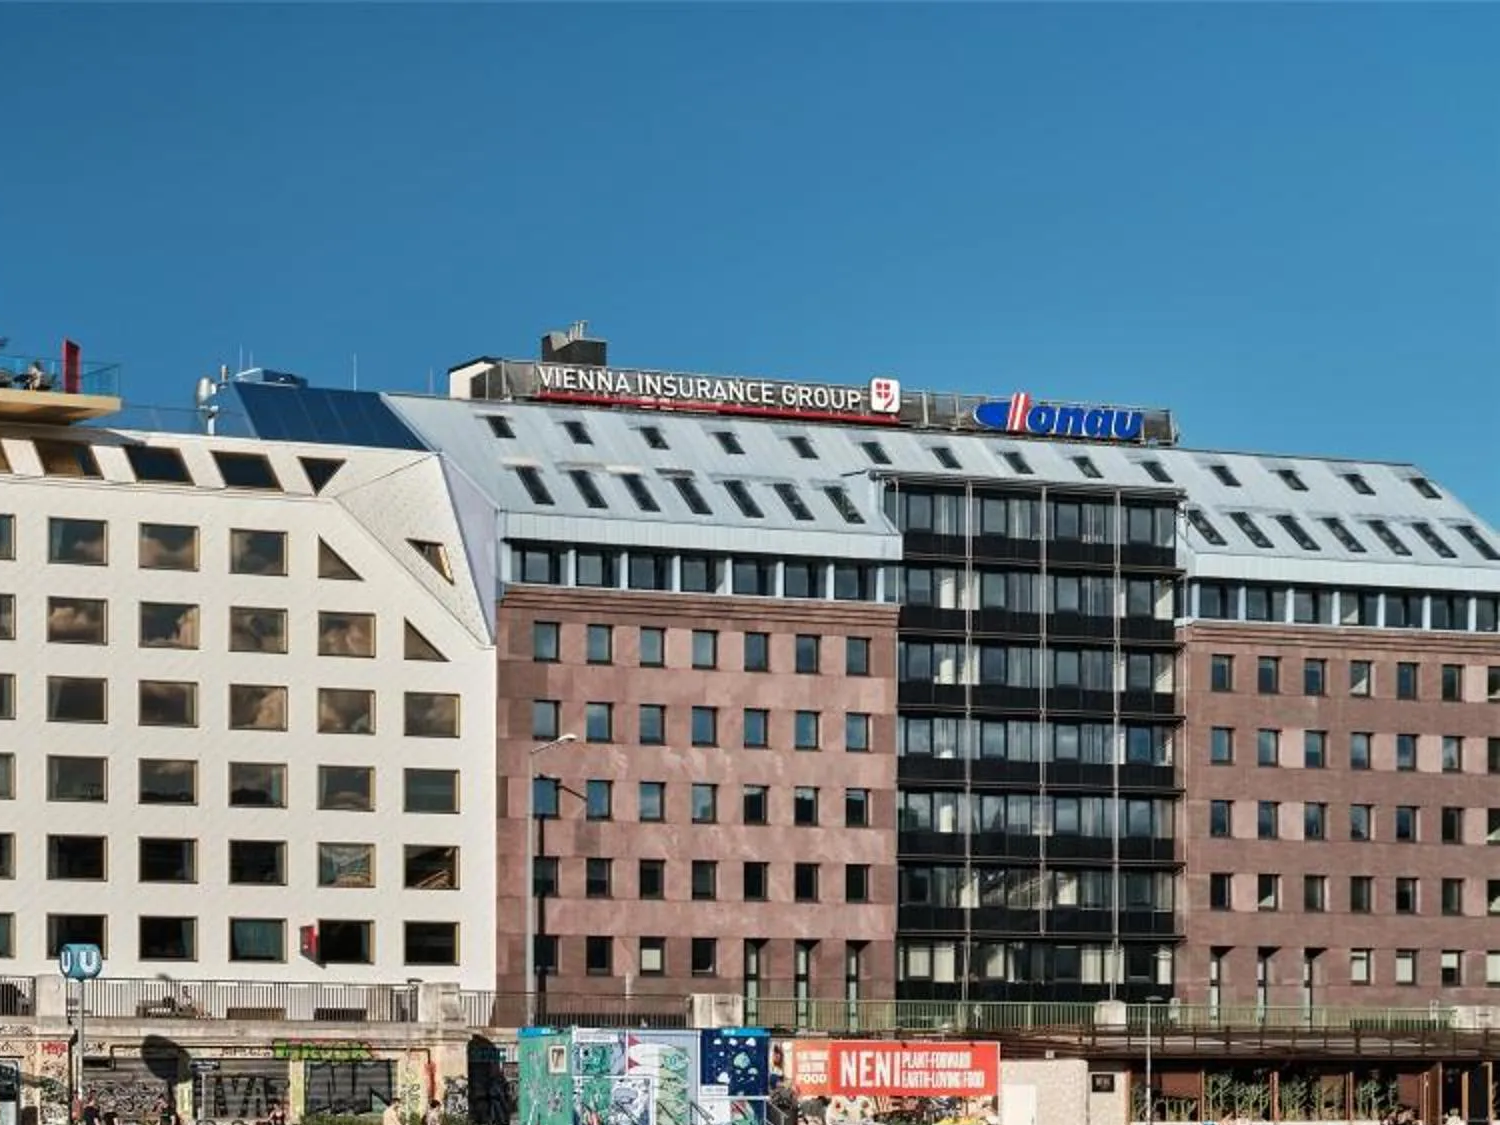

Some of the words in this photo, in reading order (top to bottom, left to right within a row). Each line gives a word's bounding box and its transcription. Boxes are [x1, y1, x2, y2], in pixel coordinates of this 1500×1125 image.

[537, 365, 631, 393] VIENNA
[637, 372, 775, 403] INSURANCE
[781, 385, 862, 410] GROUP
[61, 951, 71, 973] U
[79, 951, 97, 973] U
[840, 1050, 900, 1088] NENI
